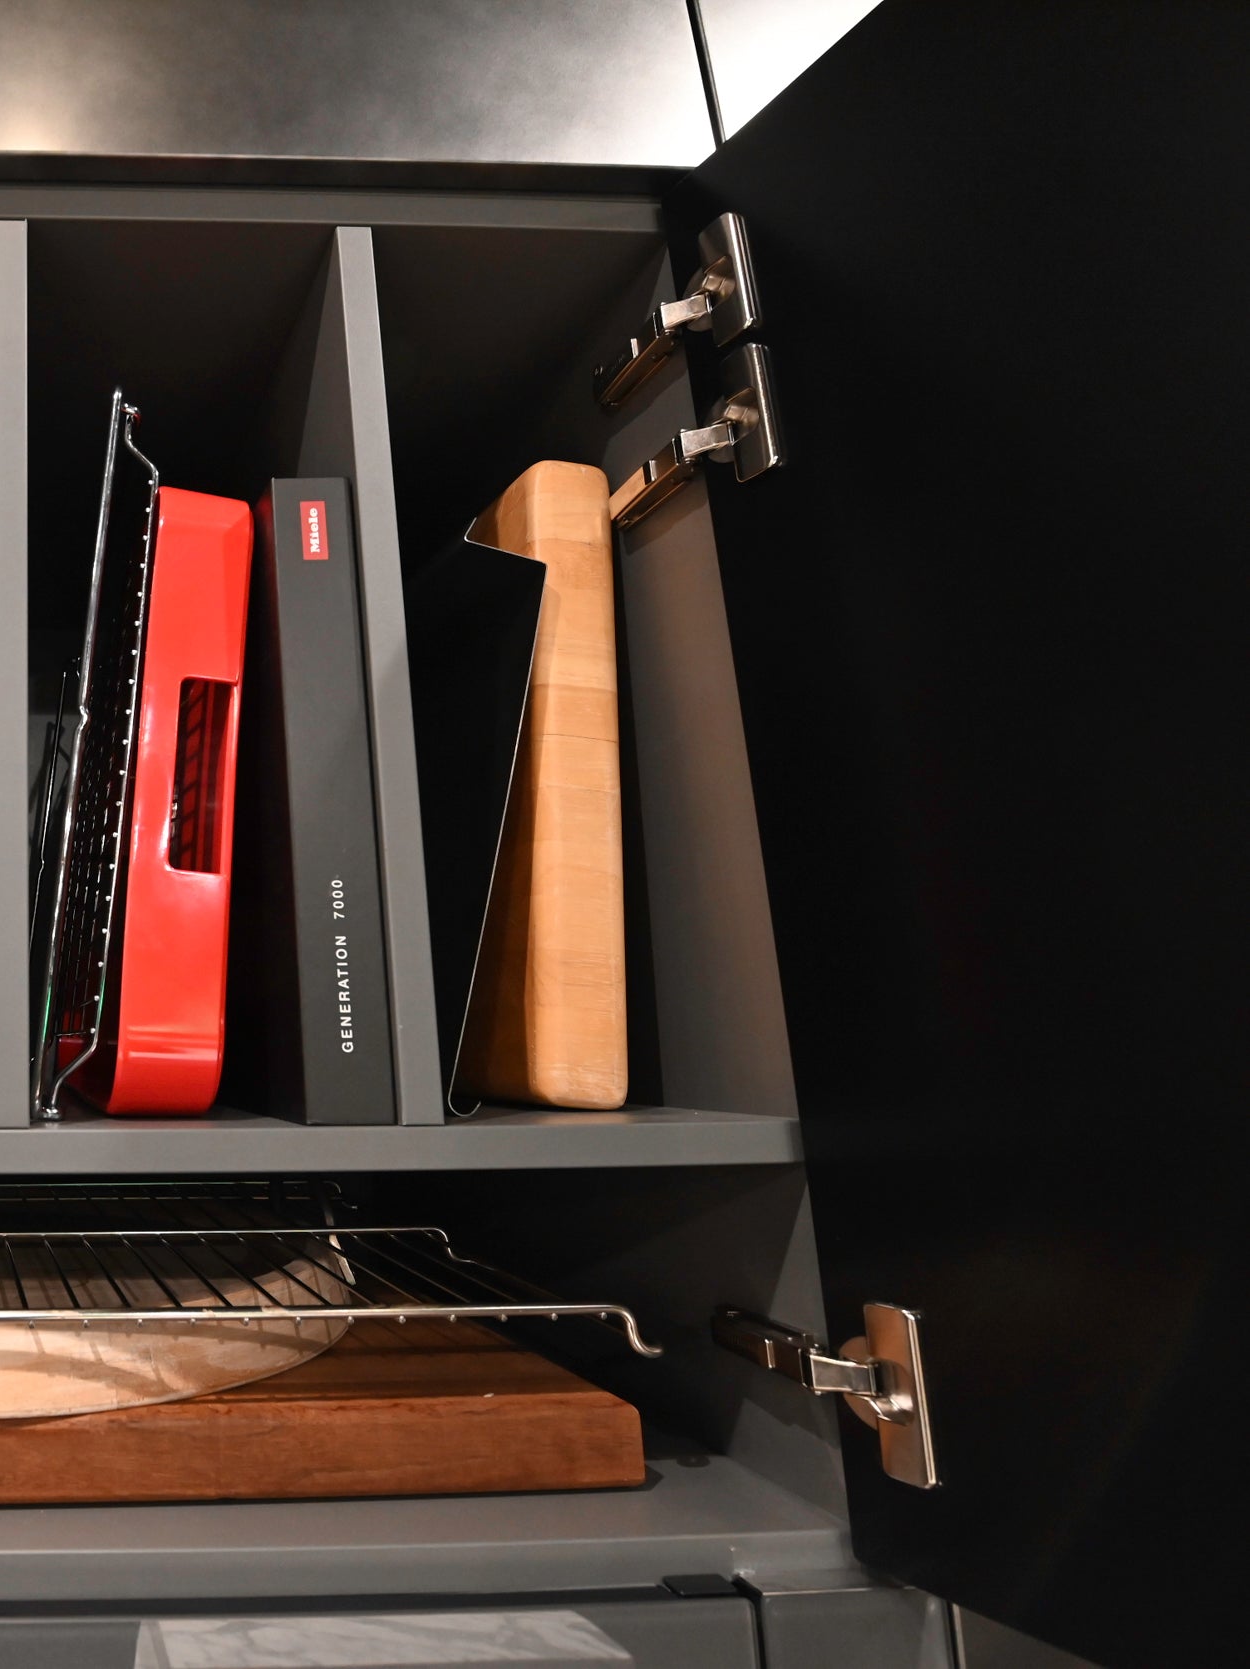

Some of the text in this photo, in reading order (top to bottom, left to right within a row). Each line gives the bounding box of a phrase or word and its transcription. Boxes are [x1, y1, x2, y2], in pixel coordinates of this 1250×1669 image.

[308, 506, 320, 554] Miele
[331, 878, 354, 1053] GENERATION 7000
